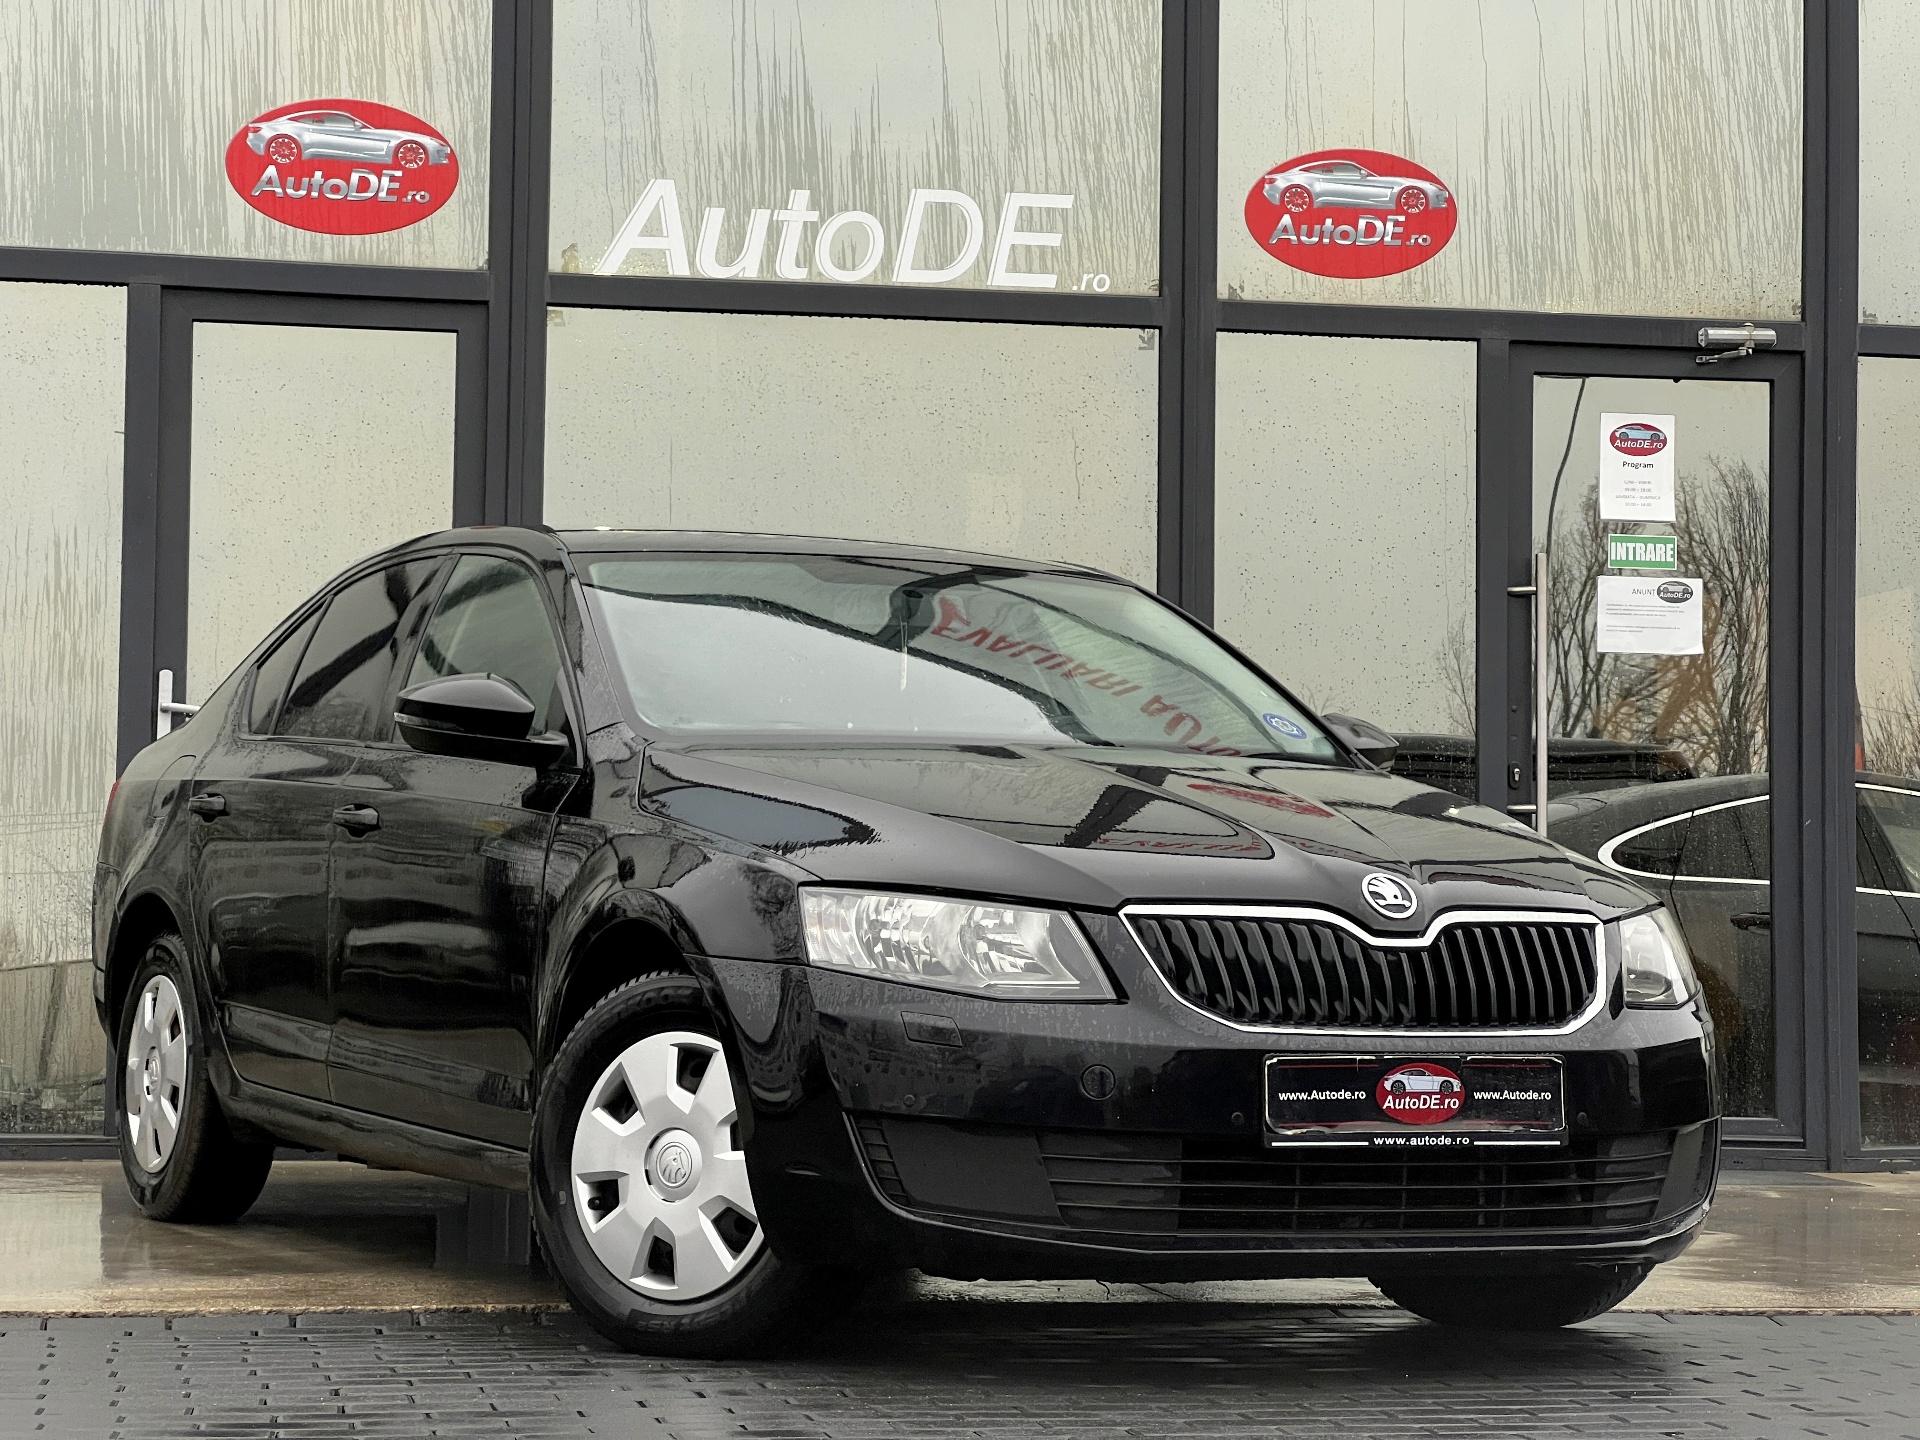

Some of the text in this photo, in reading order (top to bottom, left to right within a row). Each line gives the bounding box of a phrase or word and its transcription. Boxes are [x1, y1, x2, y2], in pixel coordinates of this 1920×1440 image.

[1622, 461, 1654, 470] Program
[1610, 541, 1674, 562] INTRARE
[1278, 1088, 1552, 1111] www.Autode.ro AutoDE.ro www.Autode.ro
[1373, 1134, 1470, 1147] www.autode.ro
